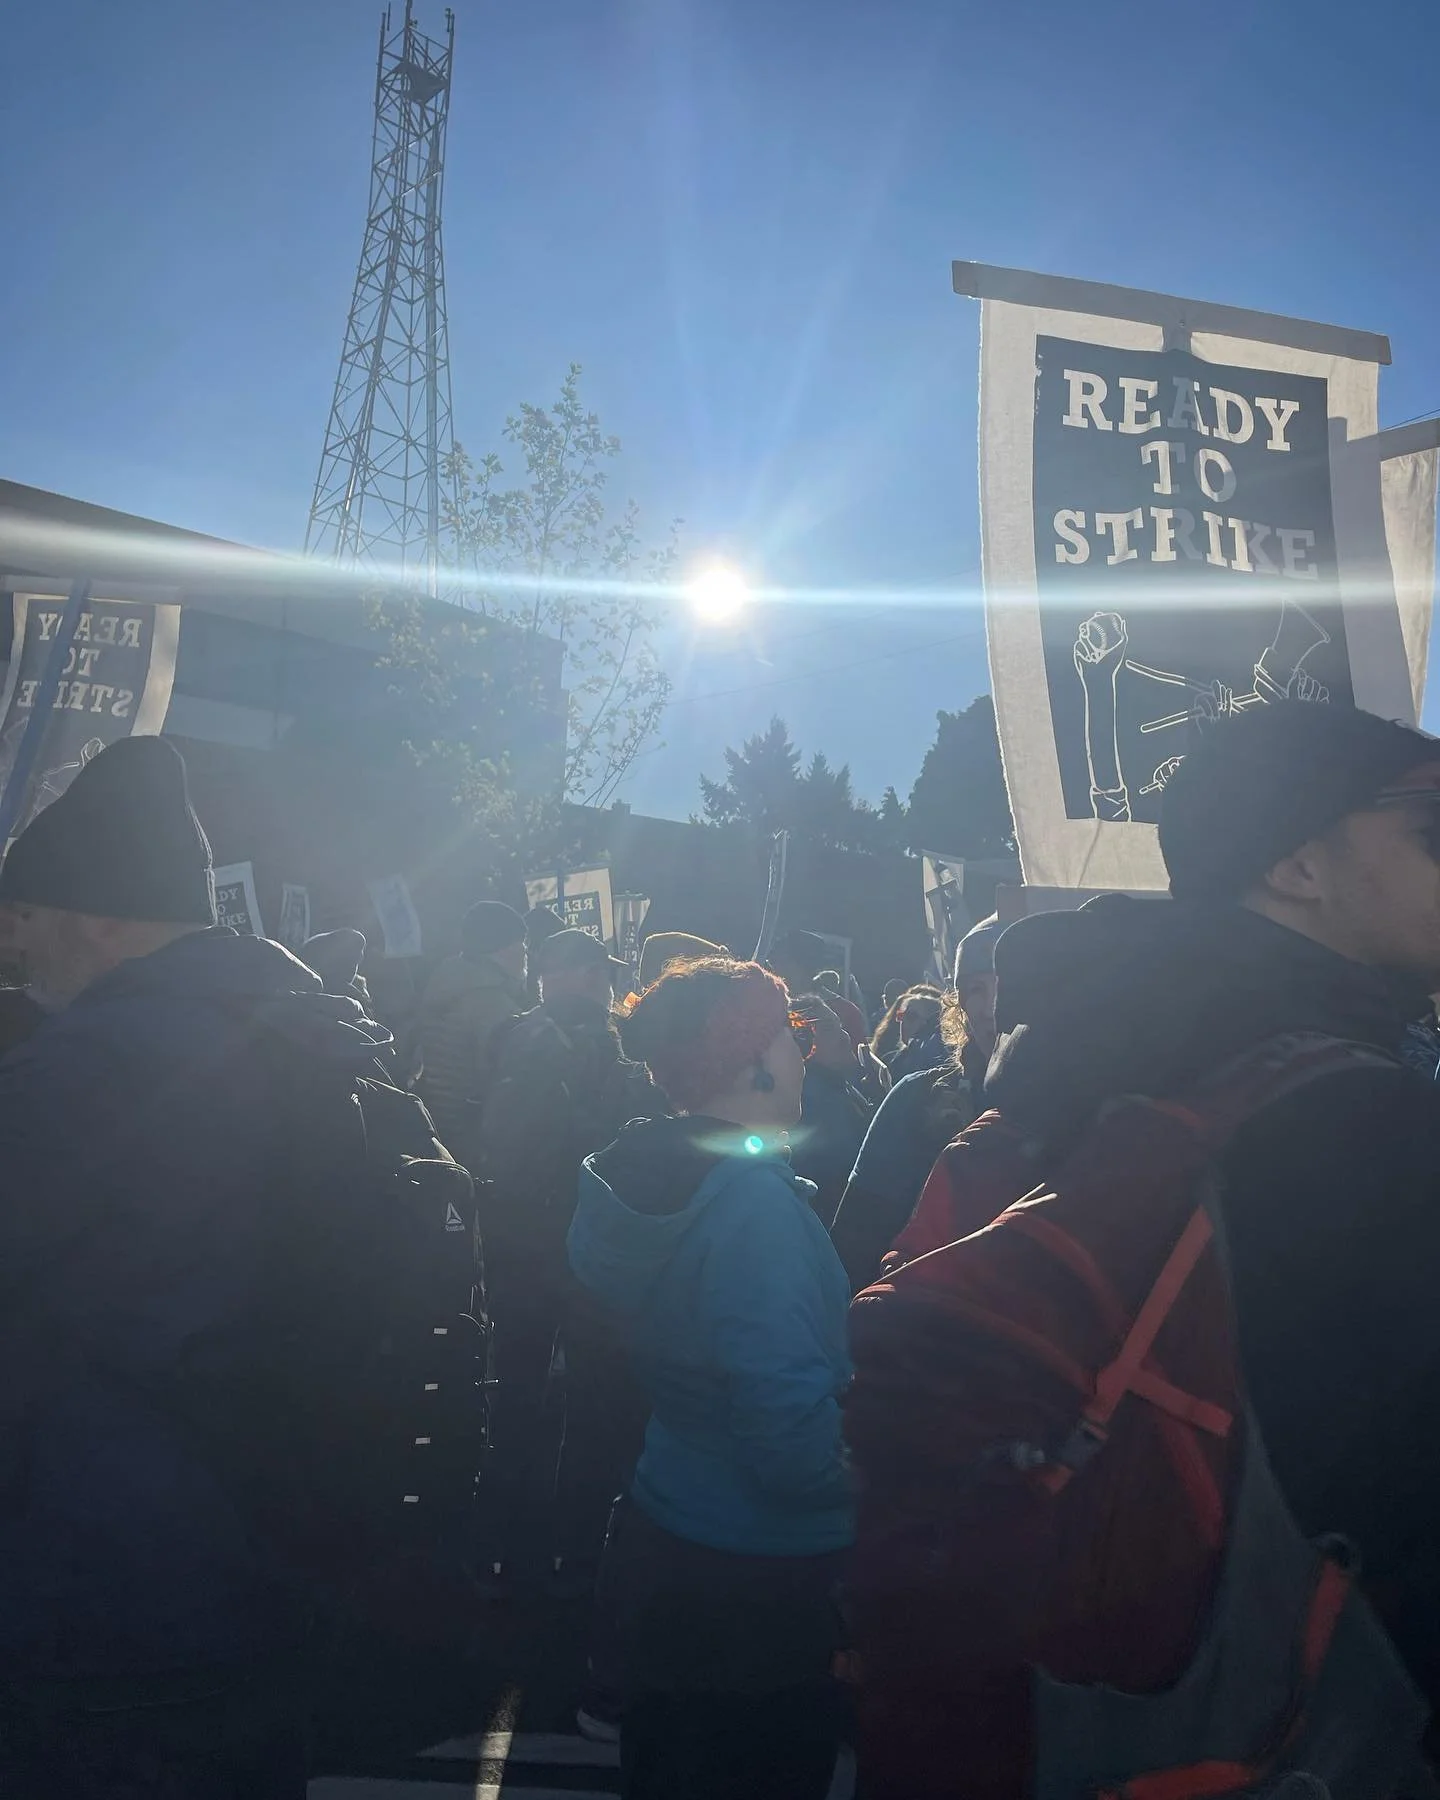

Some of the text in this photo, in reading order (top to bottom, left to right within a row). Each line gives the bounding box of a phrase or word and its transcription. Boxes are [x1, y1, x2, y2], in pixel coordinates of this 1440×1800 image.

[1062, 368, 1300, 452] READY
[1140, 441, 1237, 502] TO
[1052, 506, 1319, 580] STRIKE
